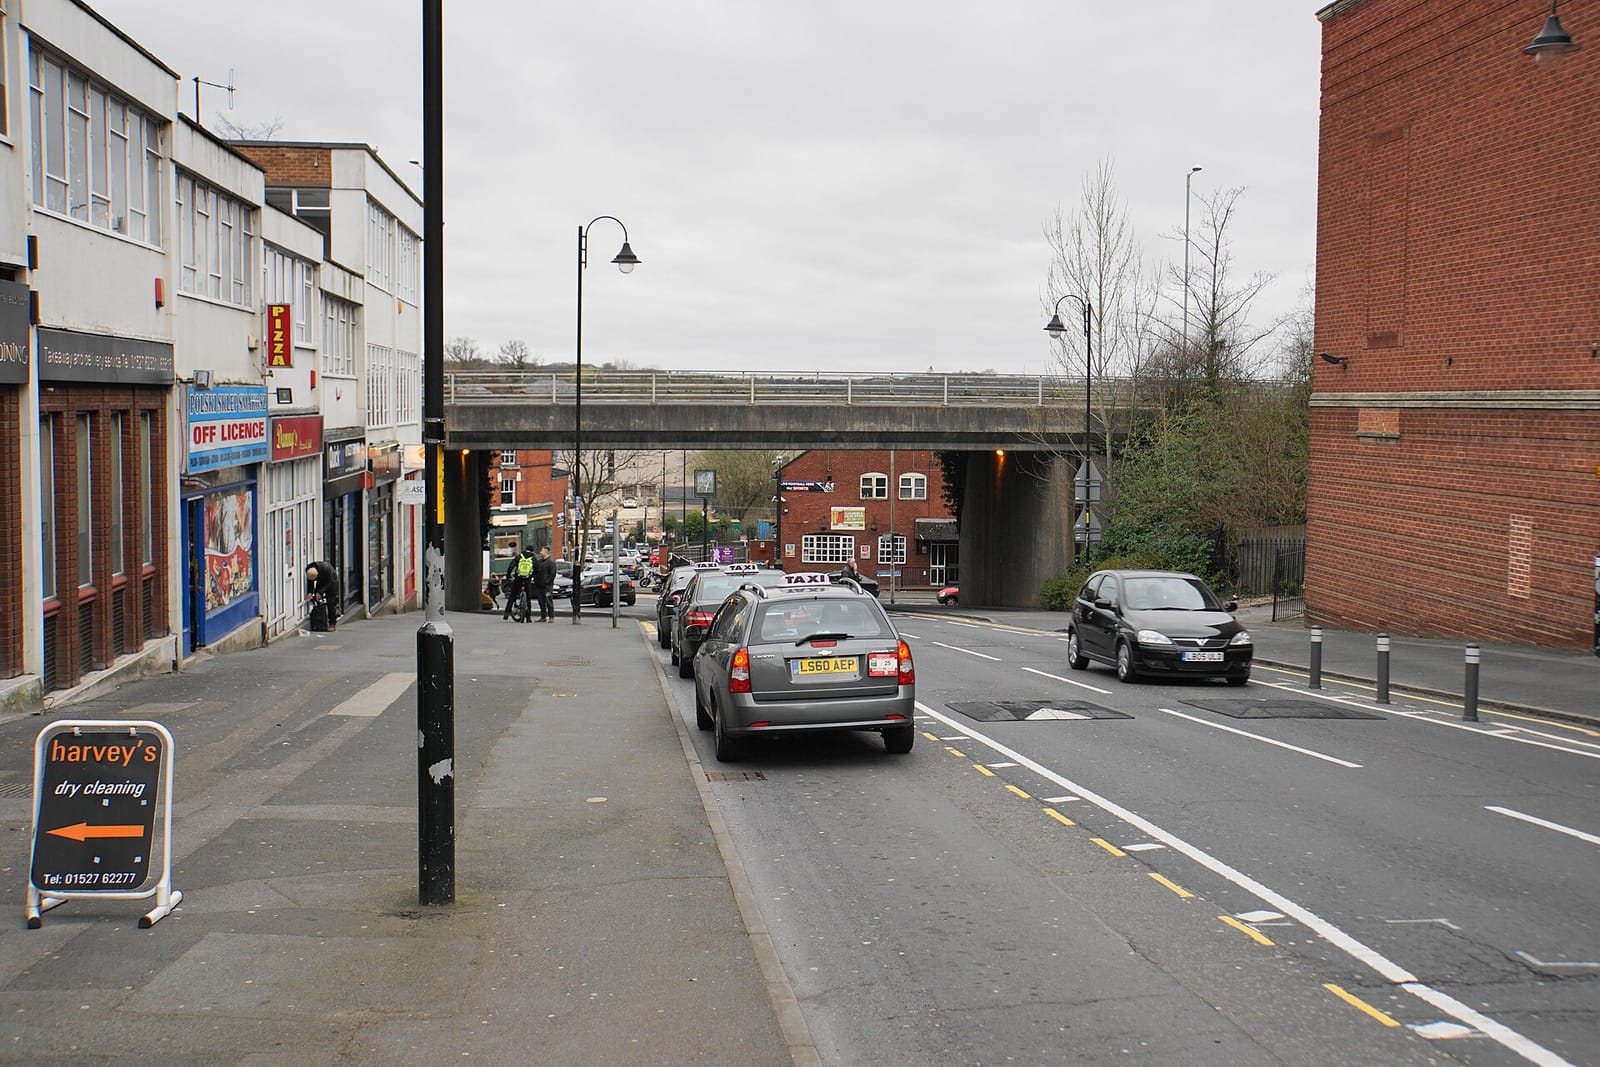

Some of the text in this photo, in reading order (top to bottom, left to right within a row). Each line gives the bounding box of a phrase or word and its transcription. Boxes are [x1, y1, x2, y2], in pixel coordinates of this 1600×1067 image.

[272, 306, 286, 366] PIZZA
[189, 394, 217, 415] POLSKI
[193, 421, 265, 445] OFF LICENCE
[785, 574, 825, 584] TAXI
[800, 659, 855, 672] LS60 AEP
[51, 739, 157, 767] harvey's
[55, 780, 146, 798] dry cleaning
[43, 873, 136, 885] Tel: 01527 62277
